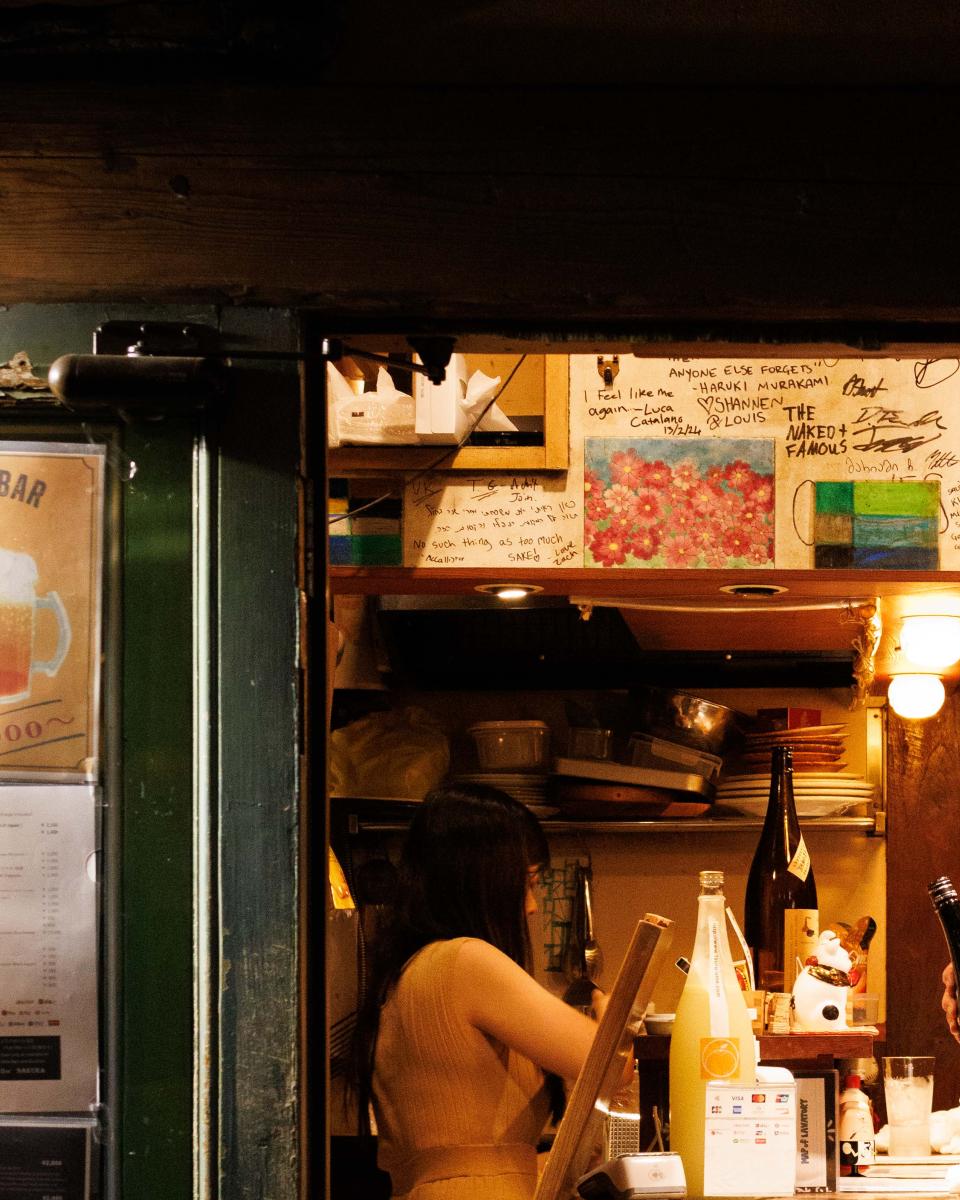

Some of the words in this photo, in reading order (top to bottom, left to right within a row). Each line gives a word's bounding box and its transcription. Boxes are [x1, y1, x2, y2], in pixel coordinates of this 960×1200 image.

[669, 367, 718, 382] ANYONE
[724, 364, 753, 376] ELSE
[757, 375, 829, 391] MURAKAMI
[598, 389, 622, 401] Feel
[629, 388, 654, 400] like
[657, 388, 675, 398] me
[714, 396, 785, 413] SHANNEN
[782, 403, 816, 422] THE
[630, 415, 684, 428] Catalano
[724, 412, 767, 428] LOUIS
[663, 424, 702, 436] 13/2/24
[785, 424, 836, 441] NAKED
[785, 439, 848, 459] FAMOUS
[413, 540, 426, 549] No
[431, 539, 456, 549] such
[462, 536, 493, 551] thing
[499, 538, 513, 546] as
[519, 536, 534, 545] too
